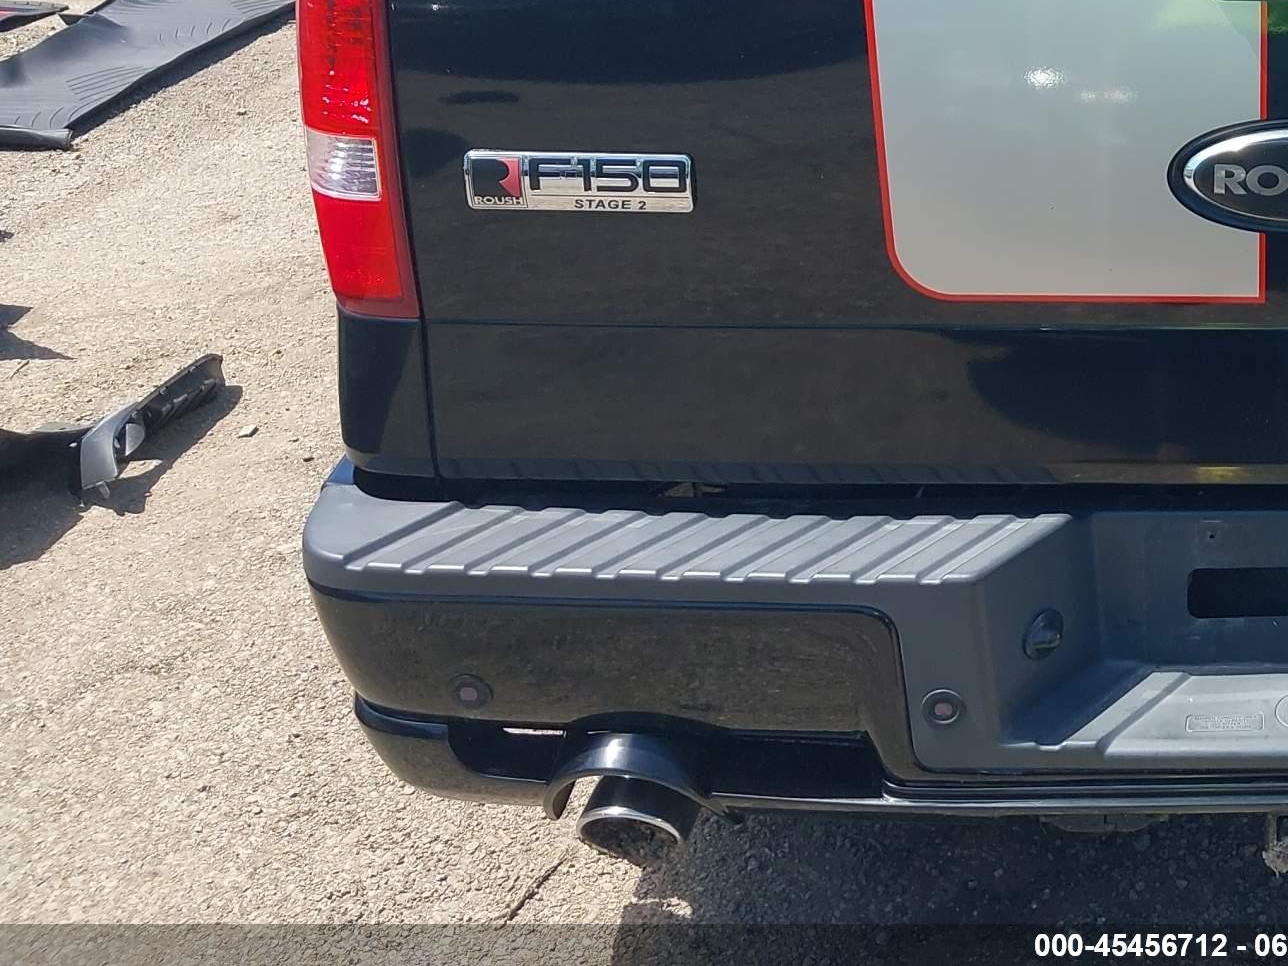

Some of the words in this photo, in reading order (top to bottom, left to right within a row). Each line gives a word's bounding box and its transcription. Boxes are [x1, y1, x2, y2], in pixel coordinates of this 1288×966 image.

[528, 158, 689, 192] F150
[474, 196, 523, 205] ROUSH
[574, 198, 631, 209] STAGE
[638, 200, 647, 210] 2
